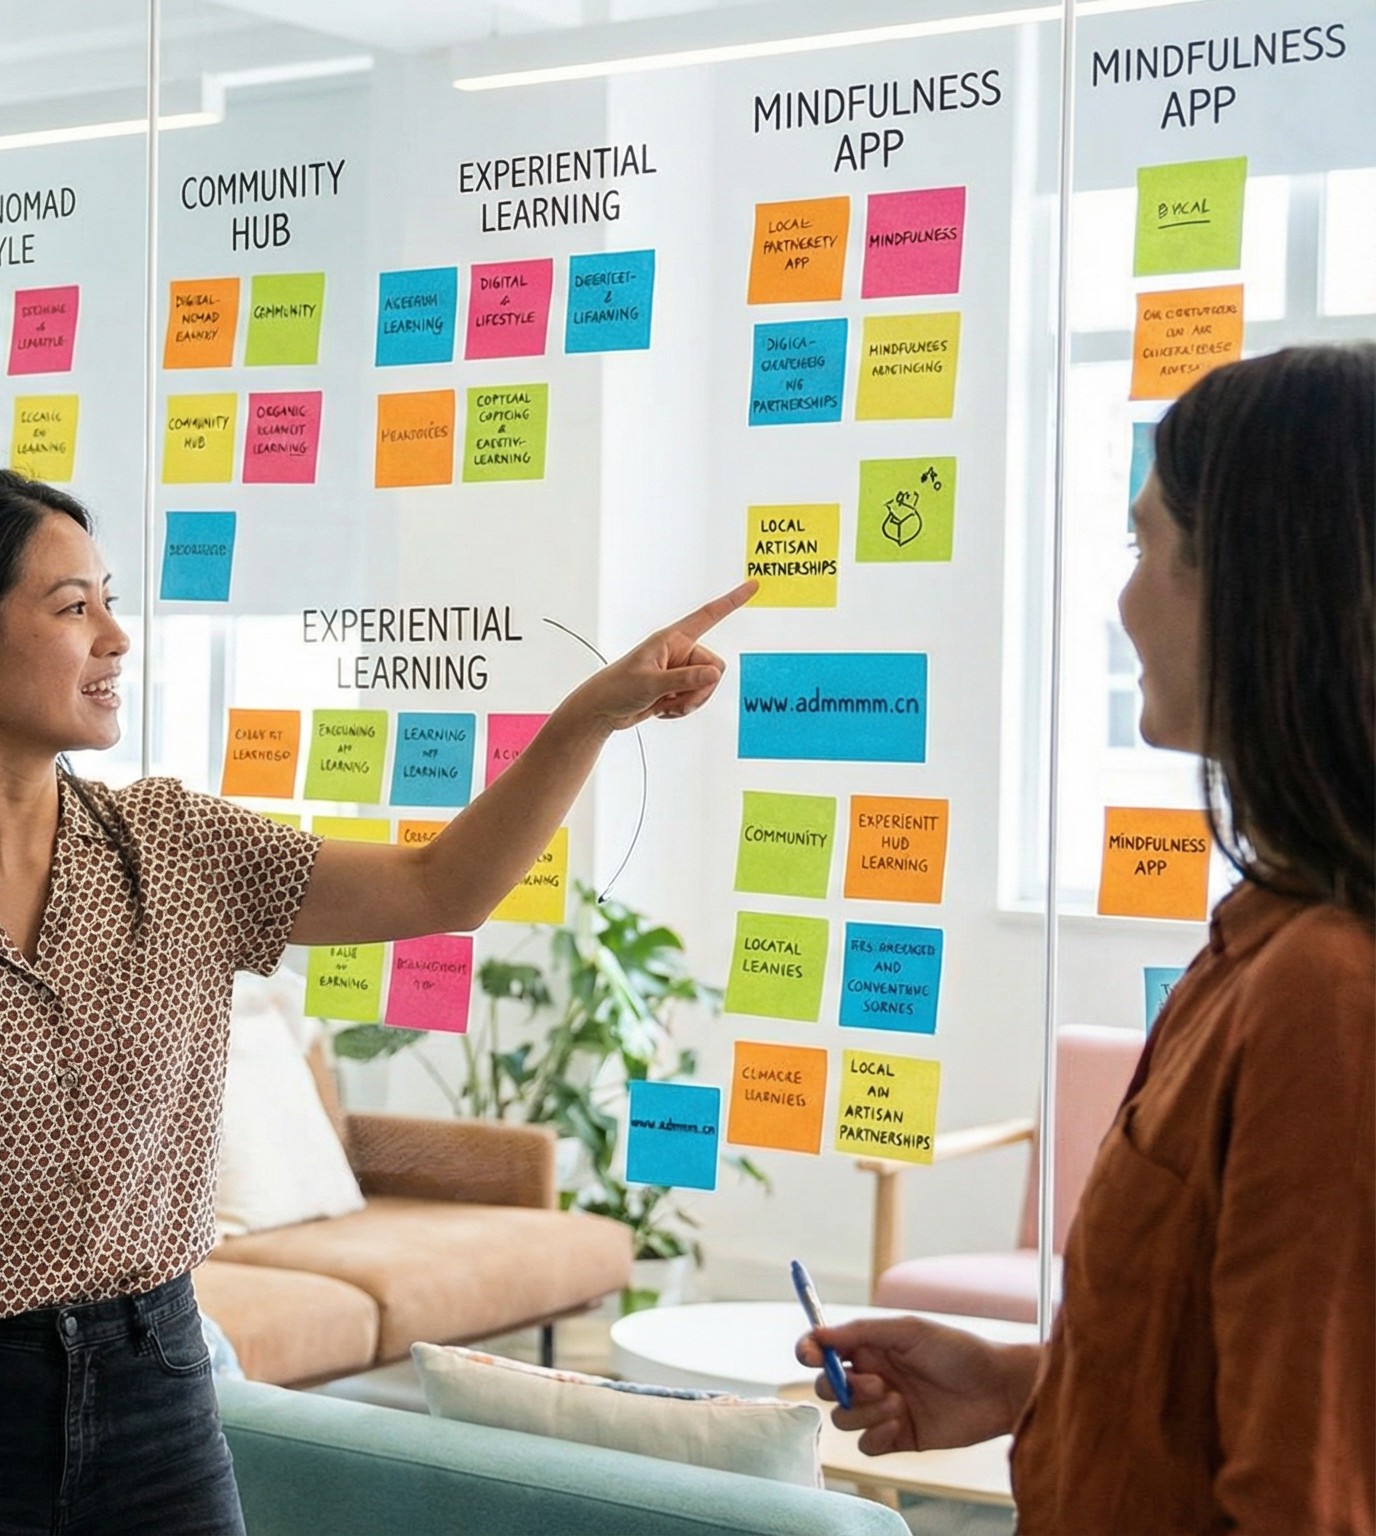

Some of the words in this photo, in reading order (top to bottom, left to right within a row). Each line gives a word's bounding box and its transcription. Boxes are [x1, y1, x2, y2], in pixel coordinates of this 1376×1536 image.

[1092, 23, 1346, 87] MINDFULNESS
[754, 69, 1002, 133] MINDFULNESS
[1160, 85, 1236, 129] APP
[833, 129, 904, 172] APP
[460, 143, 657, 193] EXPERIENTIAL
[181, 159, 346, 209] COMMUNITY
[482, 189, 620, 232] LEARNING
[231, 212, 292, 251] HUB
[480, 274, 528, 290] DIGITAL
[474, 452, 531, 466] LEARNING
[760, 519, 805, 533] LOCAL
[755, 540, 817, 554] ARTISAN
[747, 560, 837, 577] PARTNERSHIPS
[303, 606, 523, 642] EXPERIENTIAL
[337, 655, 488, 690] LEARNING
[744, 687, 919, 714] www.admmmm.cn
[404, 728, 467, 741] LEARNING
[744, 825, 828, 849] COMMUNITY
[1109, 833, 1206, 853] MINDFULNESS
[861, 855, 929, 873] LEARNING
[1133, 860, 1168, 876] APP
[744, 937, 802, 955] LOCATAL
[873, 961, 902, 974] AND
[850, 1058, 895, 1077] LOCAL
[844, 1104, 904, 1123] ARTISAN
[839, 1124, 931, 1150] PARTNERSHIPS
